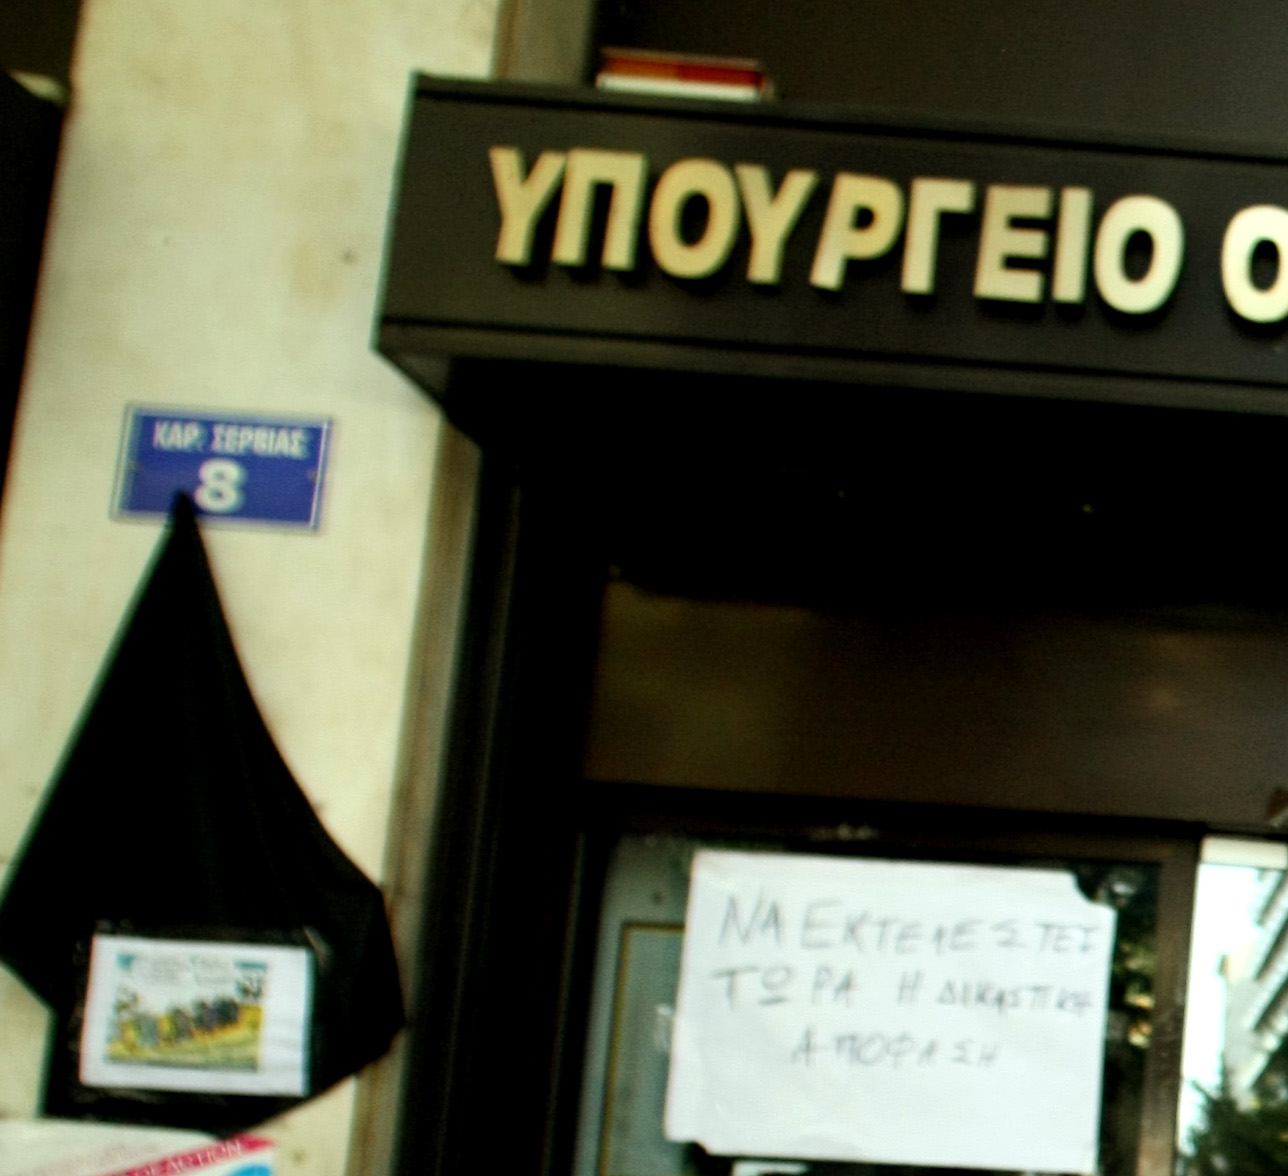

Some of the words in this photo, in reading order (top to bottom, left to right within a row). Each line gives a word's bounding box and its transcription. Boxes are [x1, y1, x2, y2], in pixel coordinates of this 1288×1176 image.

[489, 145, 1186, 316] ΥΠΟΥΡΓΕΙΟ
[211, 423, 309, 460] ΣΕΡΒΙΑΣ
[194, 458, 246, 514] 8
